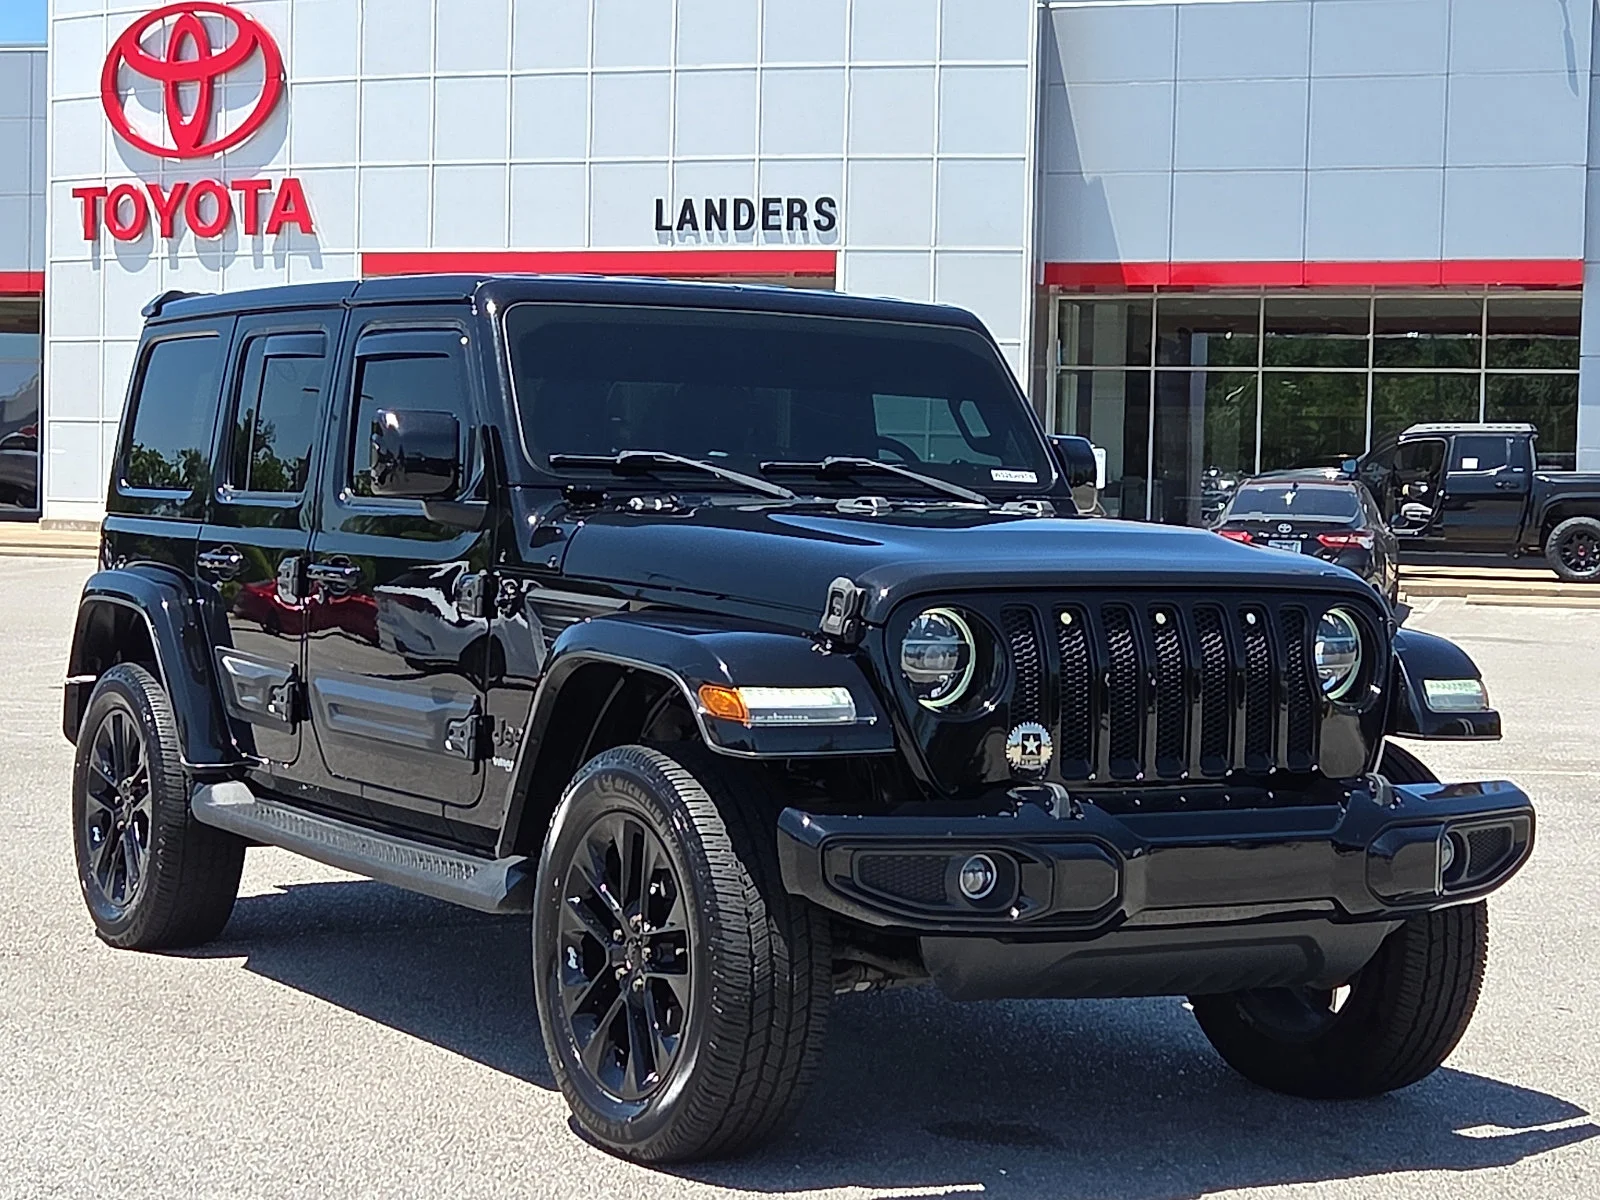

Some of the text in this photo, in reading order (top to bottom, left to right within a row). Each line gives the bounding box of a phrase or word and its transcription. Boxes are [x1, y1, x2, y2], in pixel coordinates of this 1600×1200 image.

[72, 178, 315, 241] TOYOTA
[655, 197, 836, 232] LANDERS
[492, 718, 523, 746] Jee
